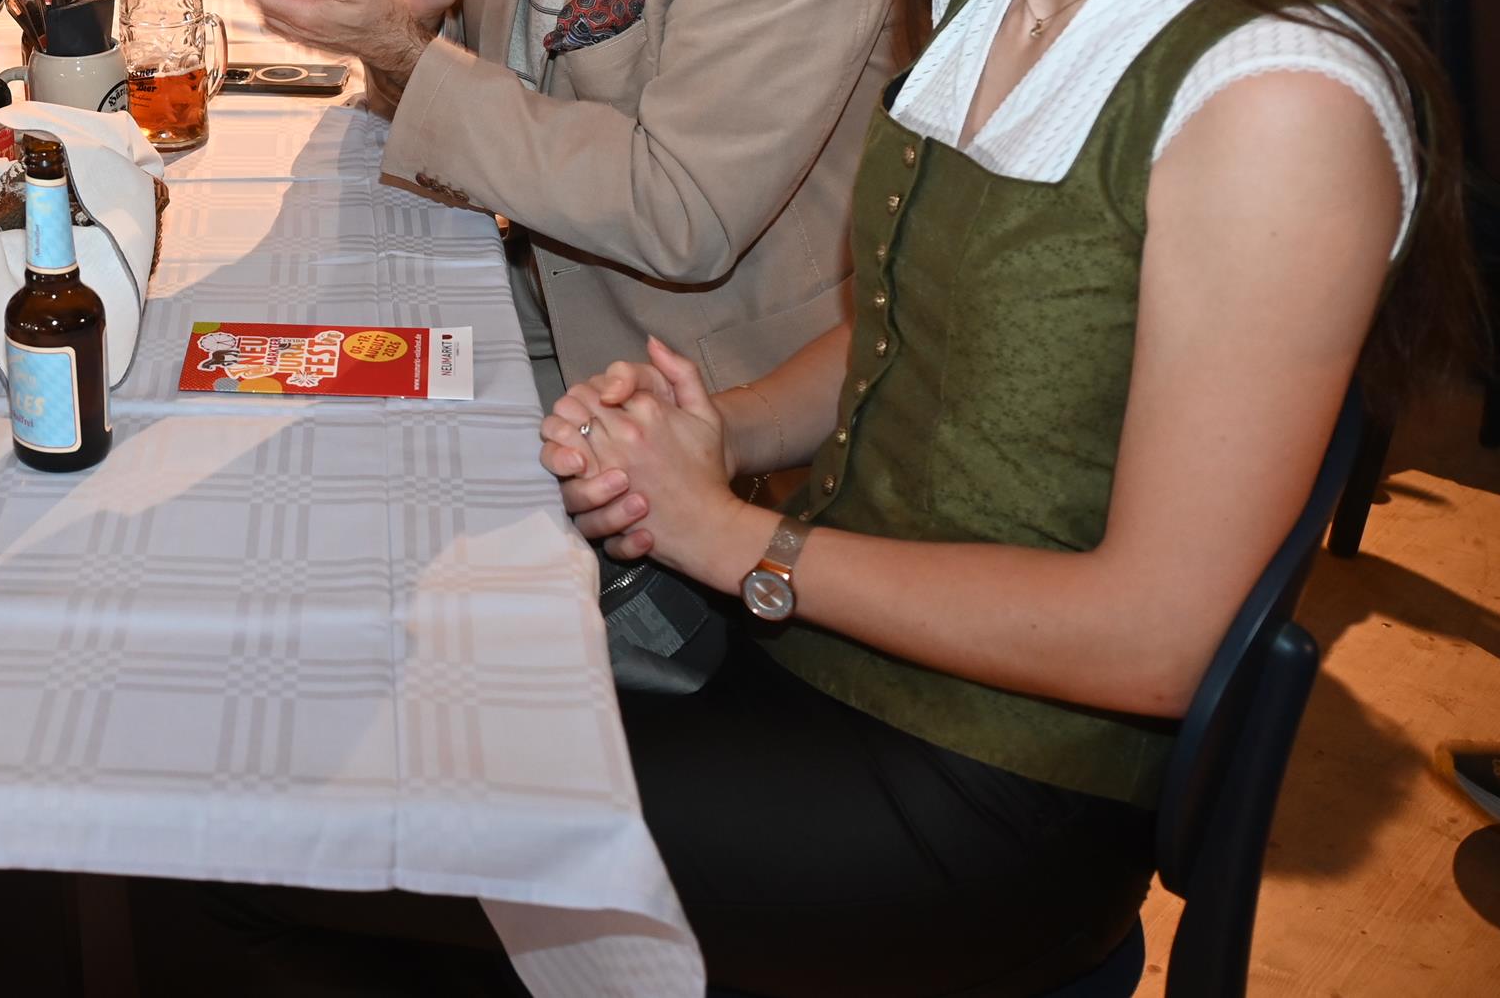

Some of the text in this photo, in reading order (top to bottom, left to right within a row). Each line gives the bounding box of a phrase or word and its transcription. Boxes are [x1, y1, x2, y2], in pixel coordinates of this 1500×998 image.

[239, 337, 268, 366] NEU
[266, 338, 279, 366] MARKTER
[278, 342, 306, 373] JURA
[305, 339, 337, 376] FEST
[365, 334, 389, 359] AUGUST
[441, 340, 452, 376] NEUMARKT
